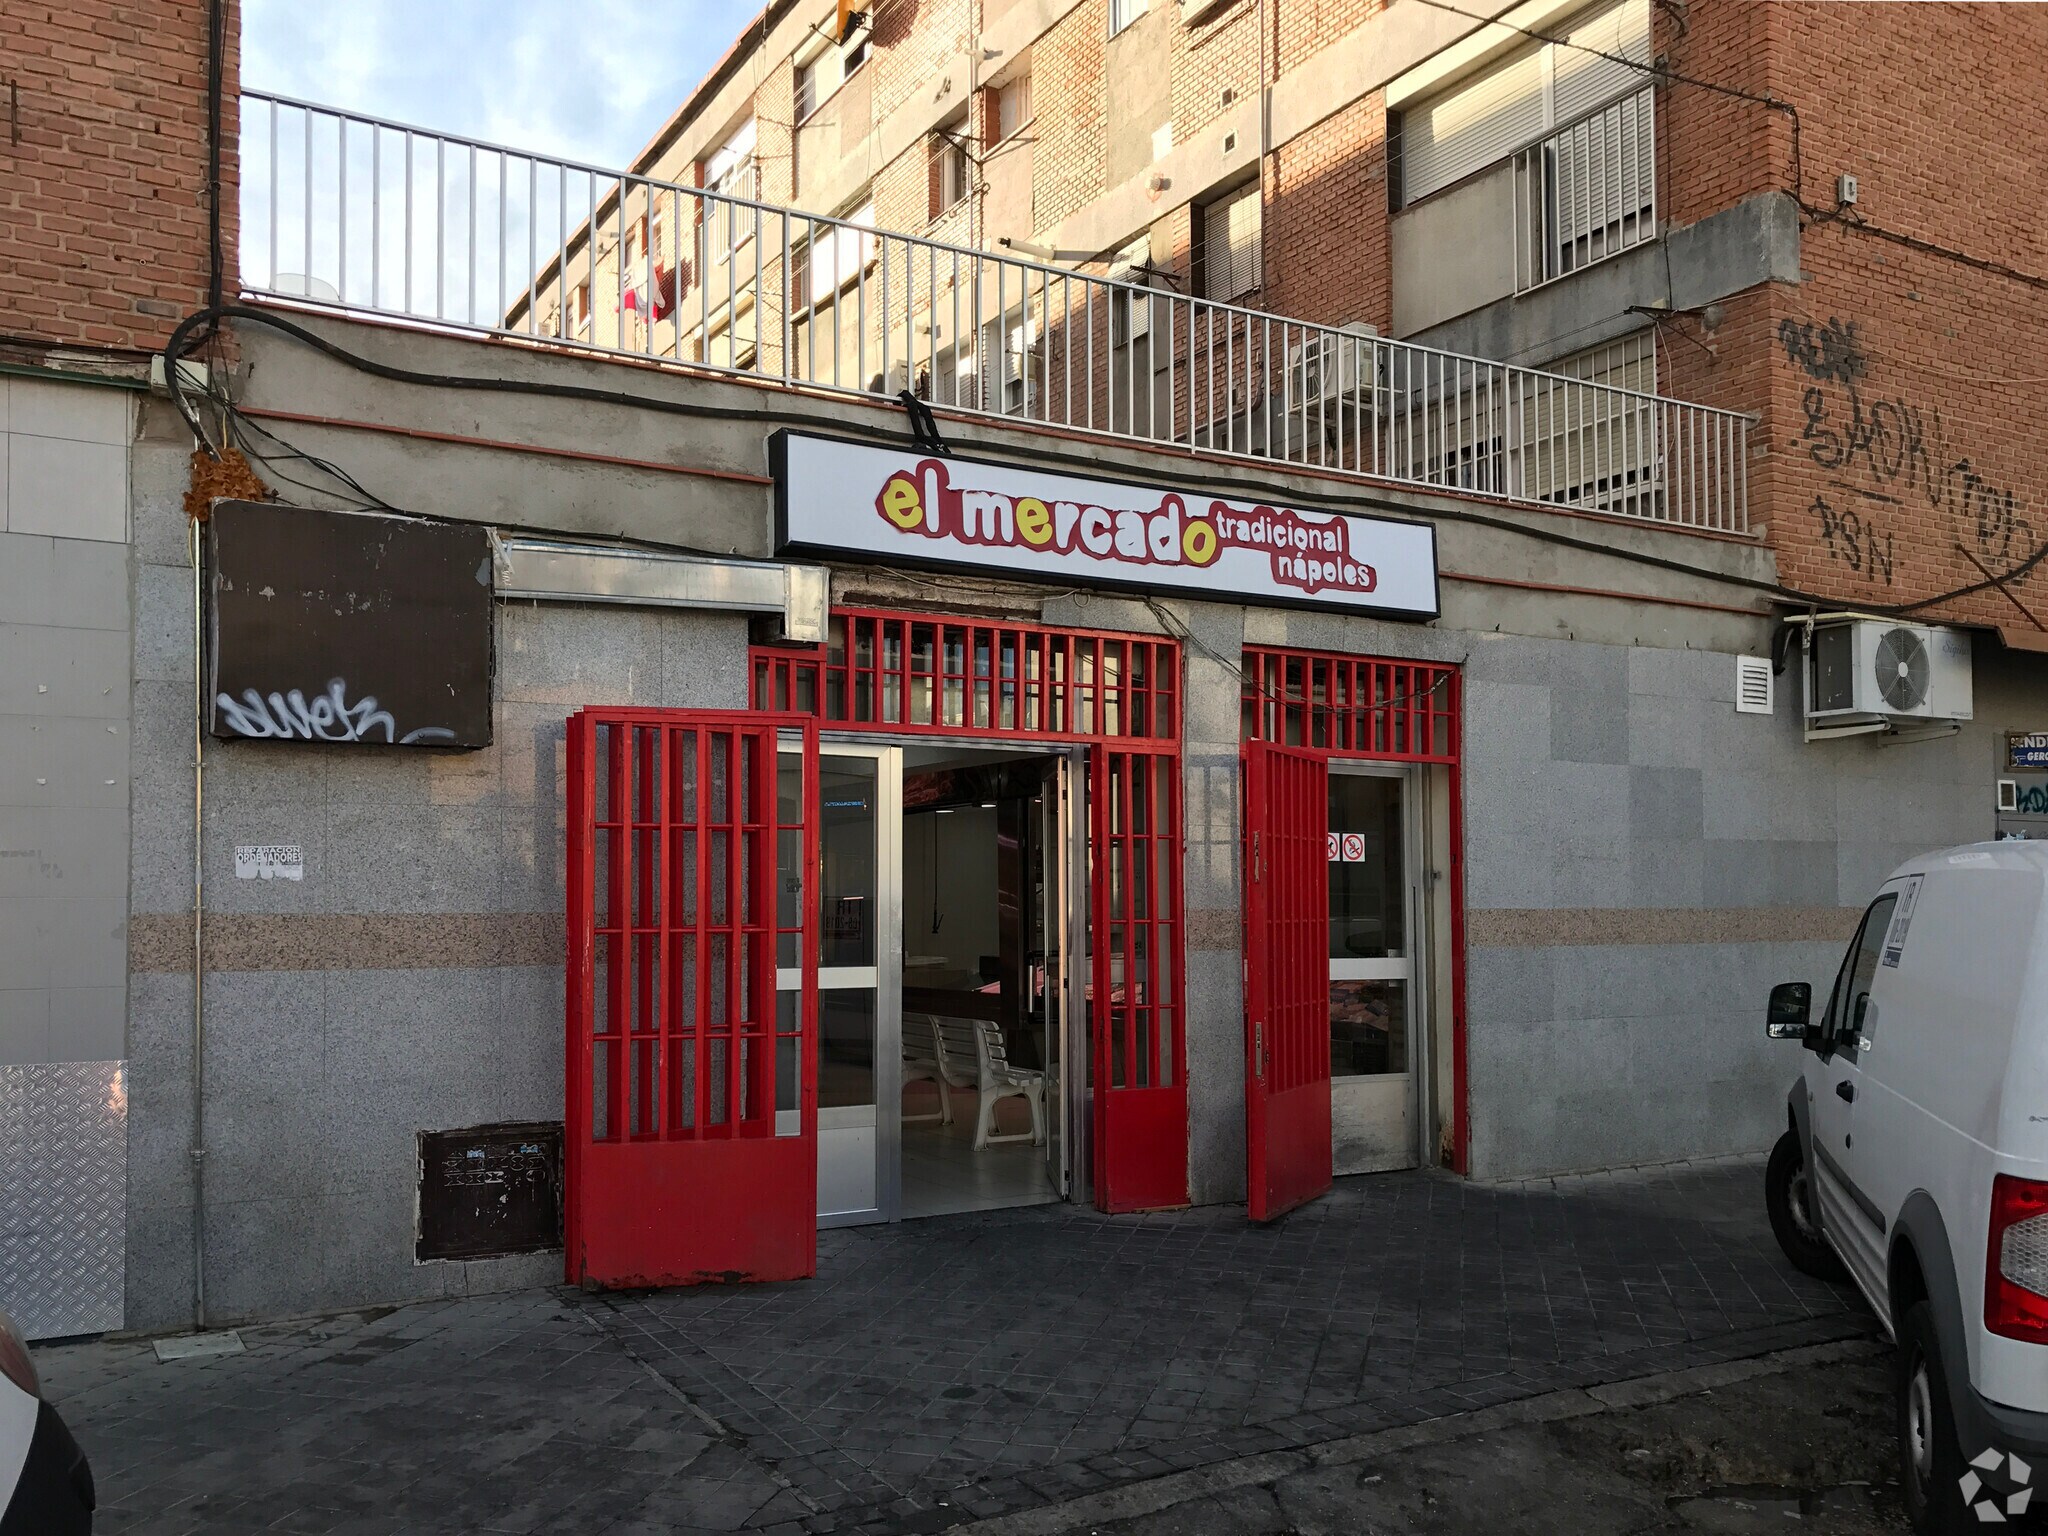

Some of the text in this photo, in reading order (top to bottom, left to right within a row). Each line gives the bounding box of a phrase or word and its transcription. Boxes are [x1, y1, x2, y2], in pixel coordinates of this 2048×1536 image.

[883, 467, 1217, 564] el mercado
[1216, 511, 1342, 553] tradicional
[1279, 552, 1370, 586] nápoles
